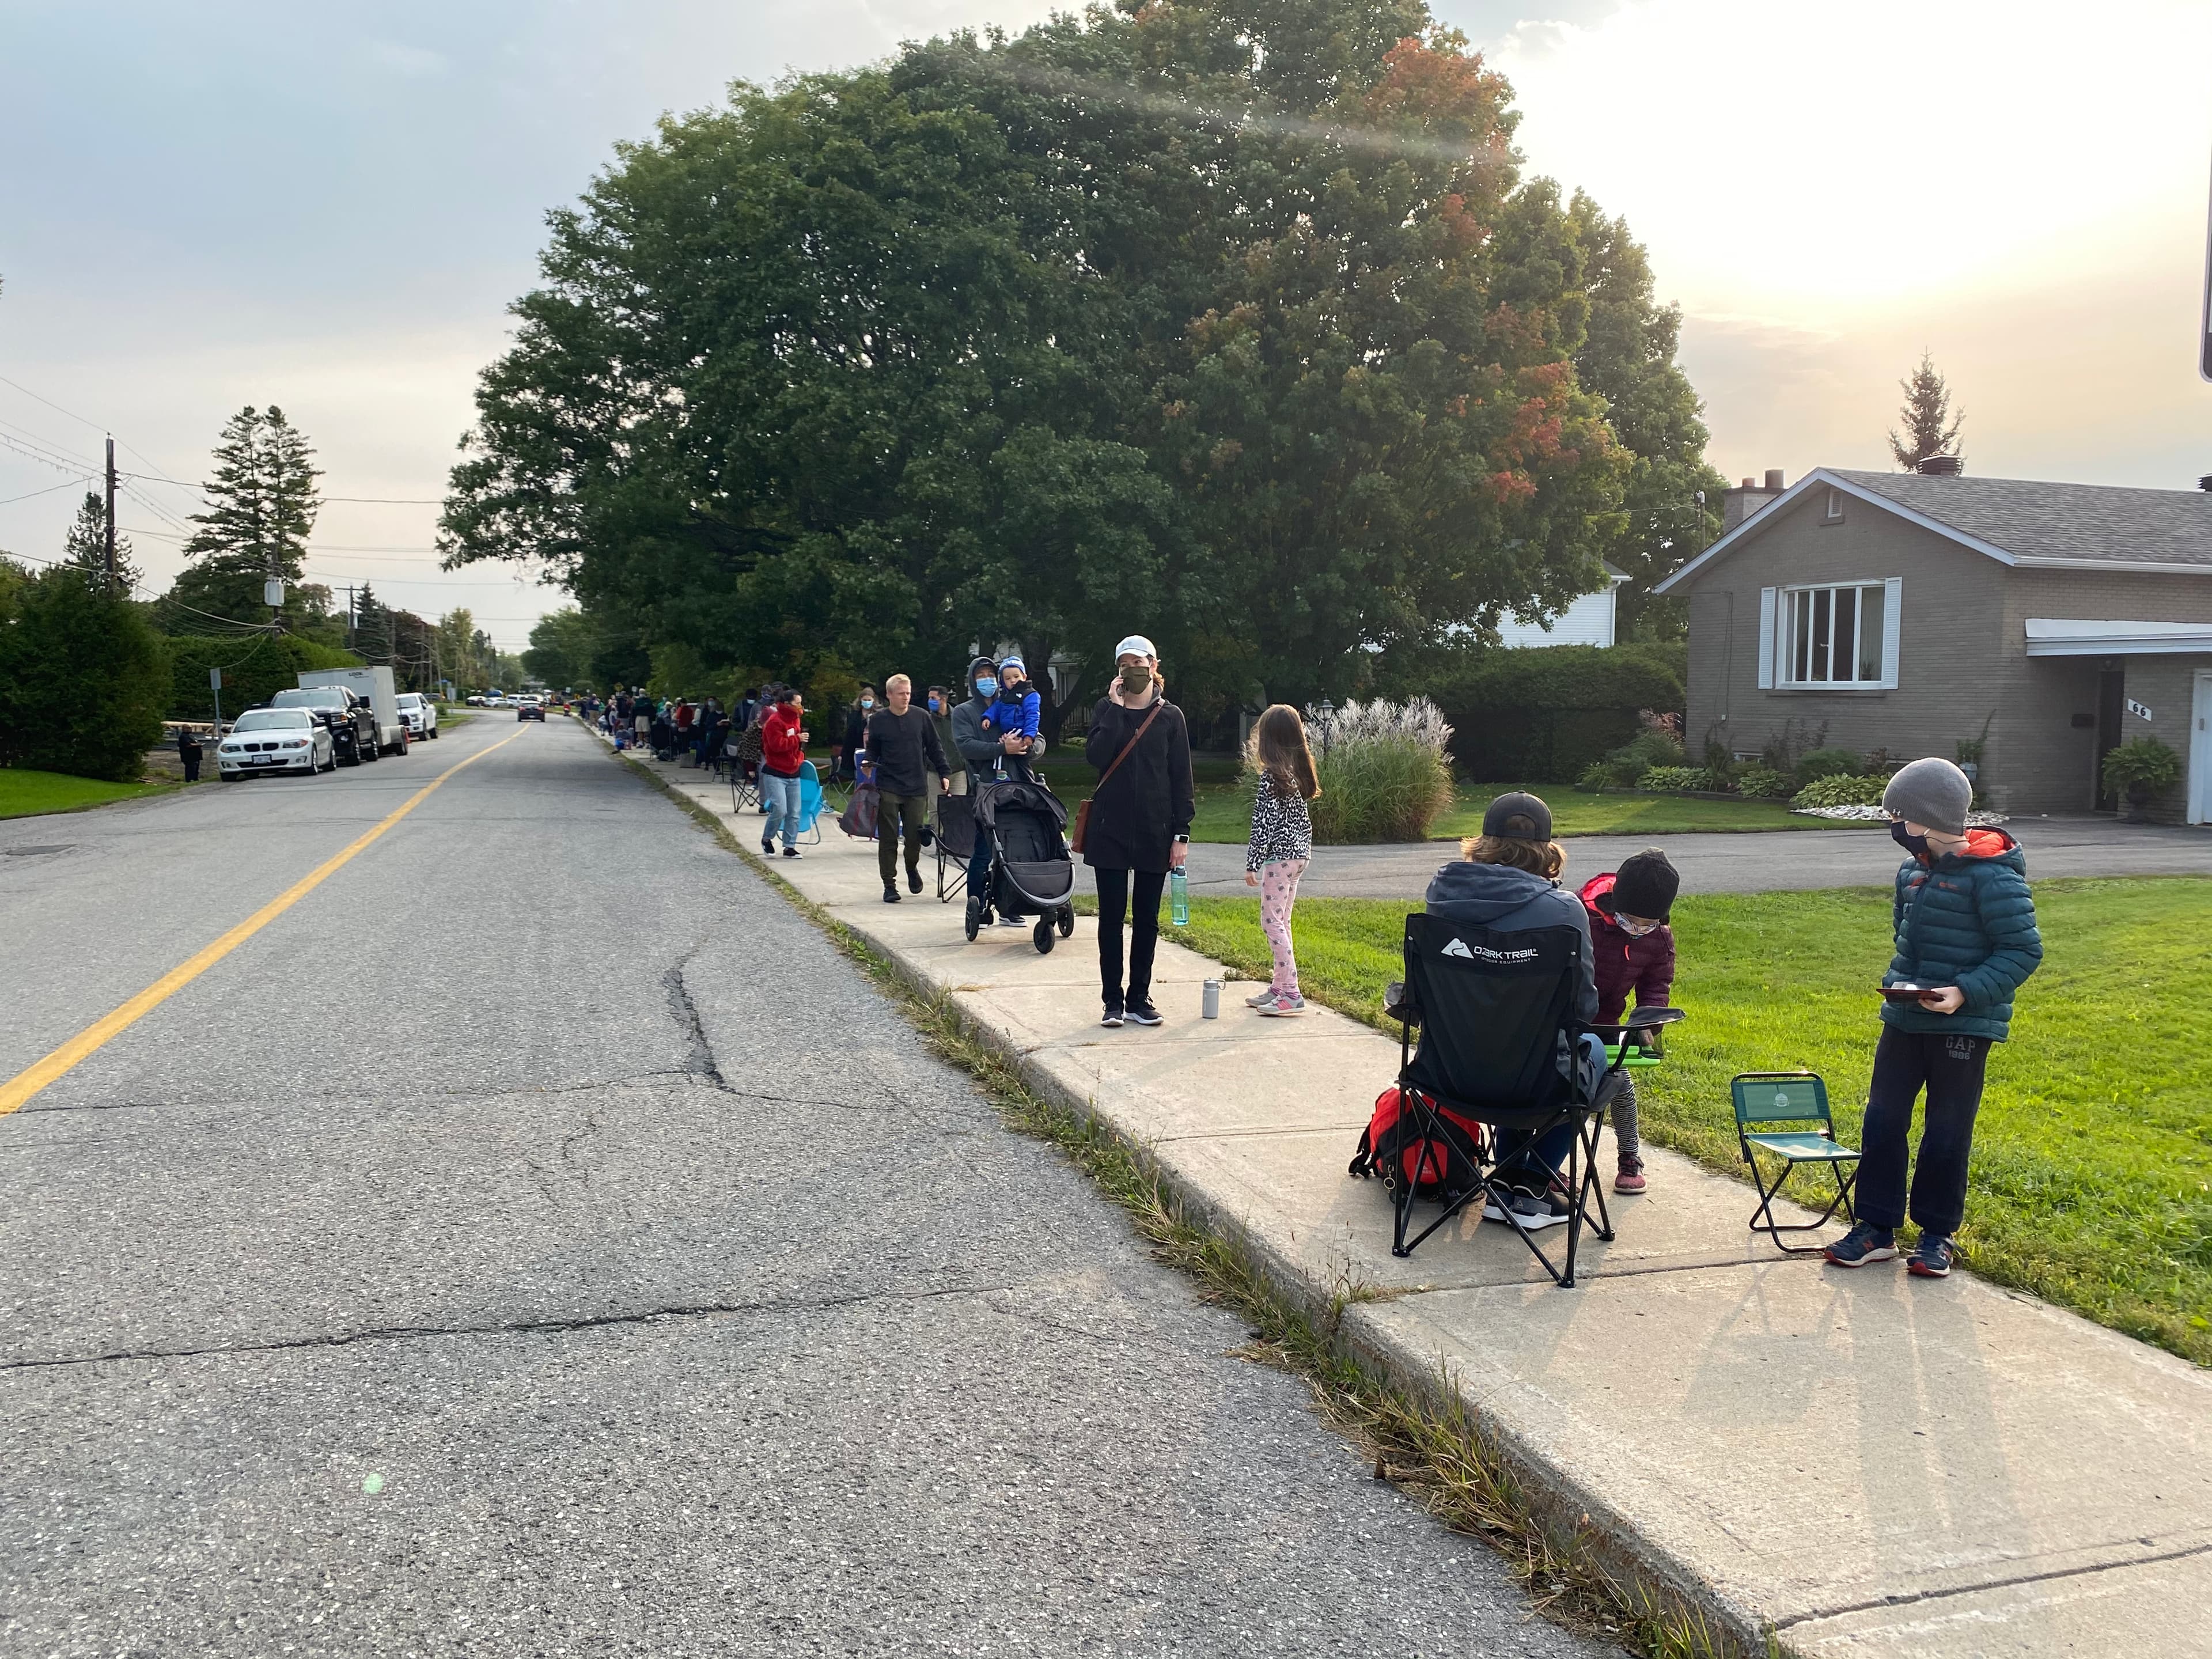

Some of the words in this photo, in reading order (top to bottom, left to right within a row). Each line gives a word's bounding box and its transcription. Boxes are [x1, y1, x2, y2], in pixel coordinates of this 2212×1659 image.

[2133, 703, 2146, 716] 66
[1474, 946, 1503, 959] OZARK
[1946, 1036, 1976, 1053] GAP
